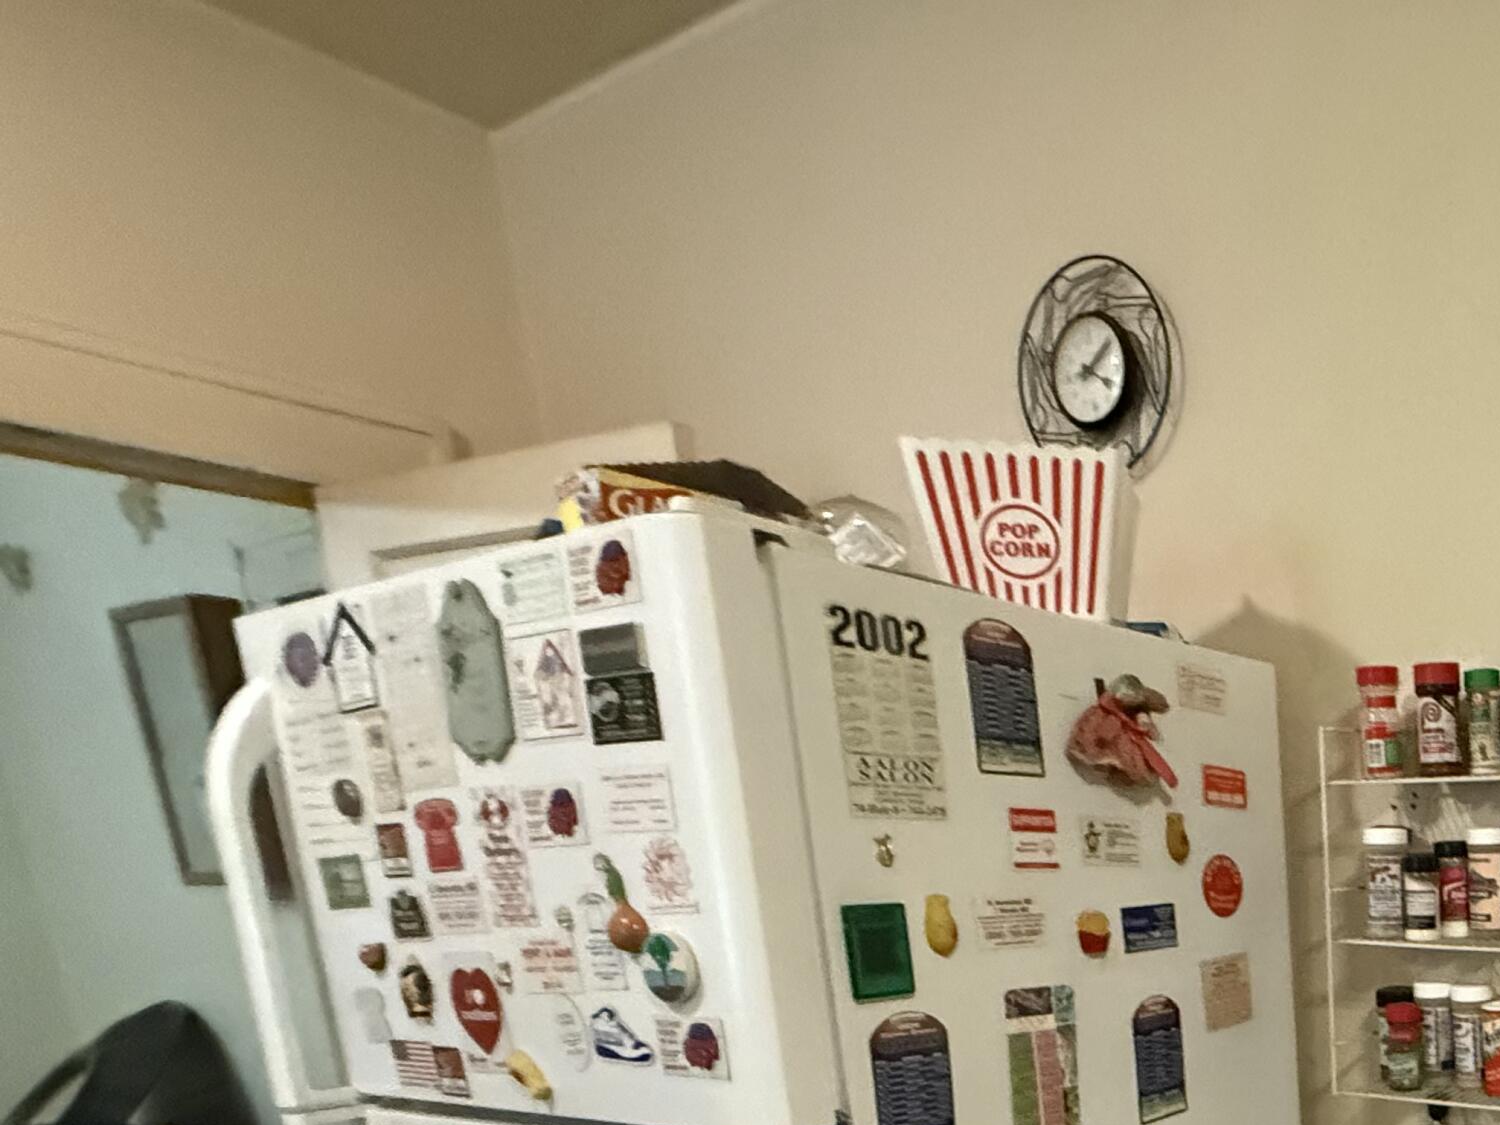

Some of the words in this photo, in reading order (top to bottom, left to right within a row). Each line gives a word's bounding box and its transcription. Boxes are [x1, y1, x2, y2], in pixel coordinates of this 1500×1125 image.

[997, 522, 1040, 540] POP
[990, 541, 1051, 559] CORN
[826, 604, 931, 662] 2002
